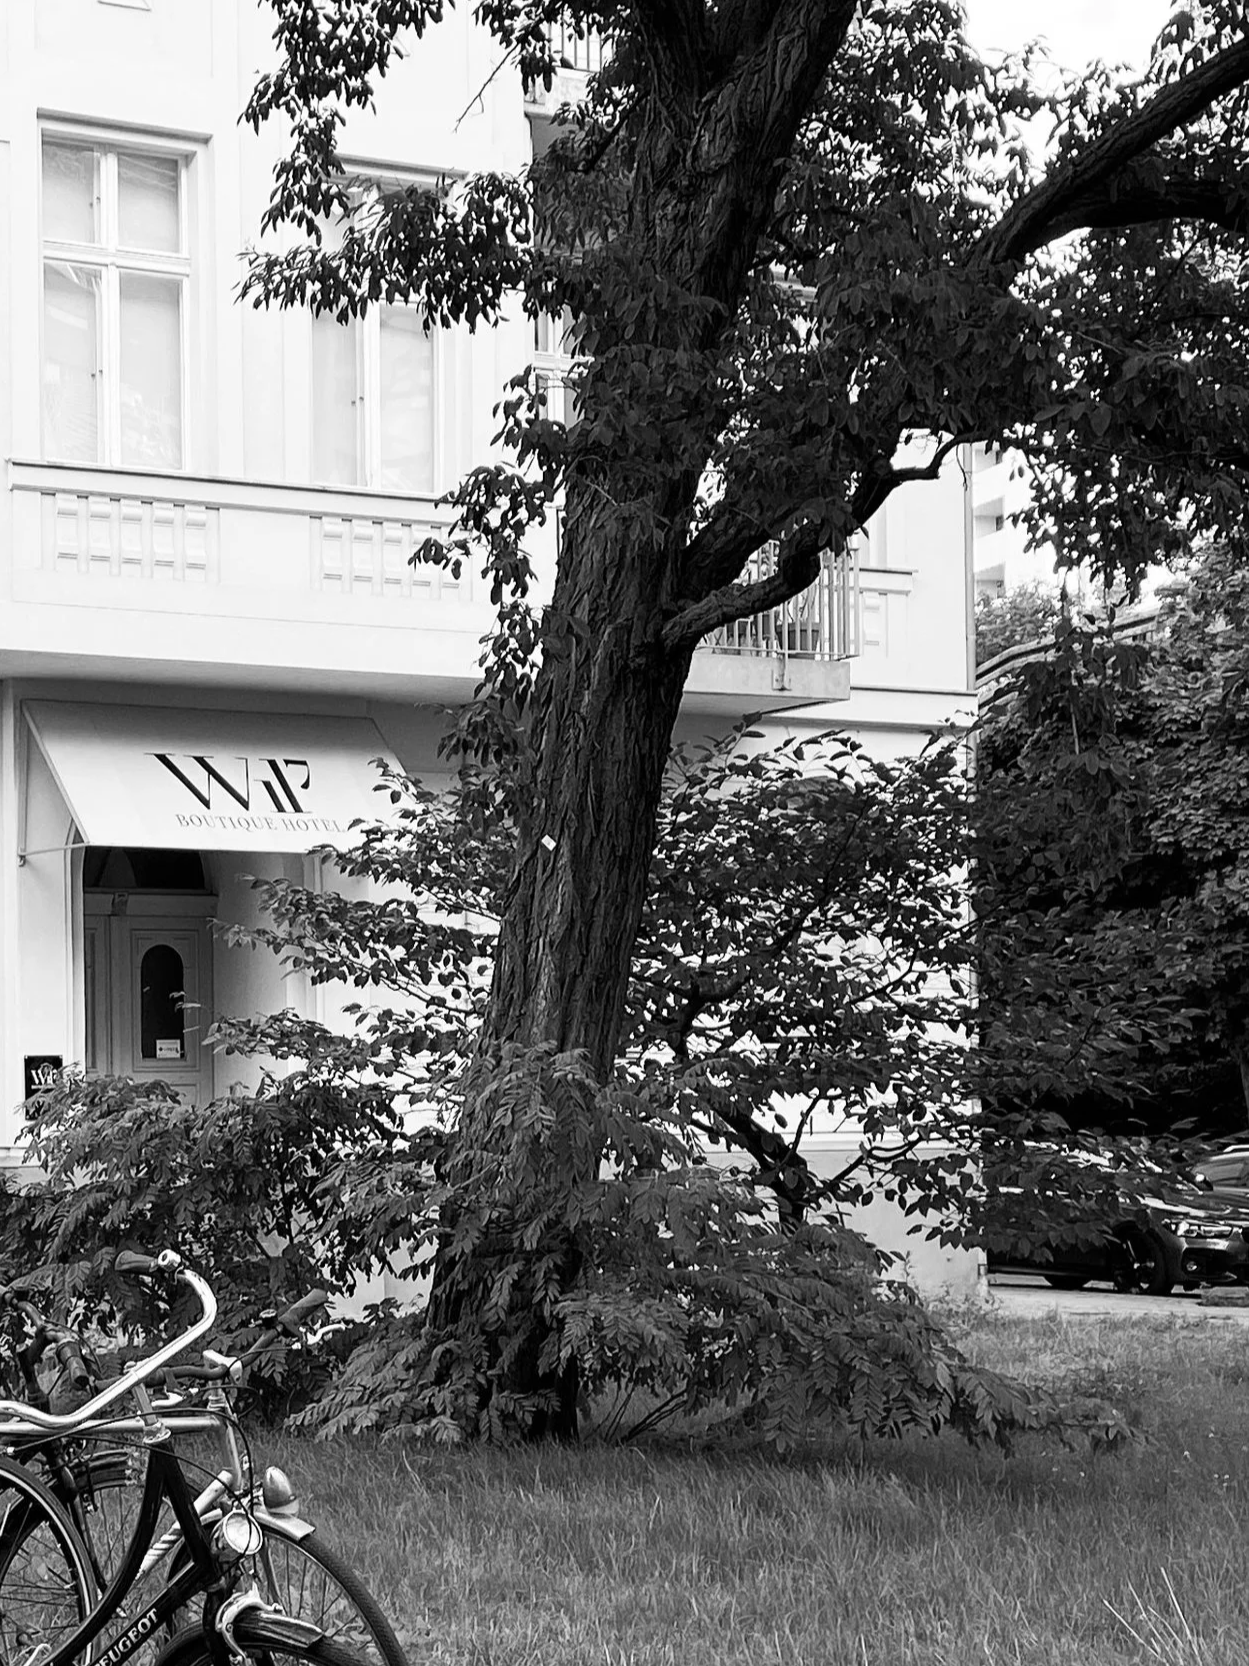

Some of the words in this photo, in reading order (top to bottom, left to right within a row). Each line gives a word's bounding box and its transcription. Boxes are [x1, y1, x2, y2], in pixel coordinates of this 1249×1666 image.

[176, 814, 277, 831] BOUTIQUE
[281, 818, 347, 832] HOTEL
[94, 1607, 157, 1666] EUGEOT
